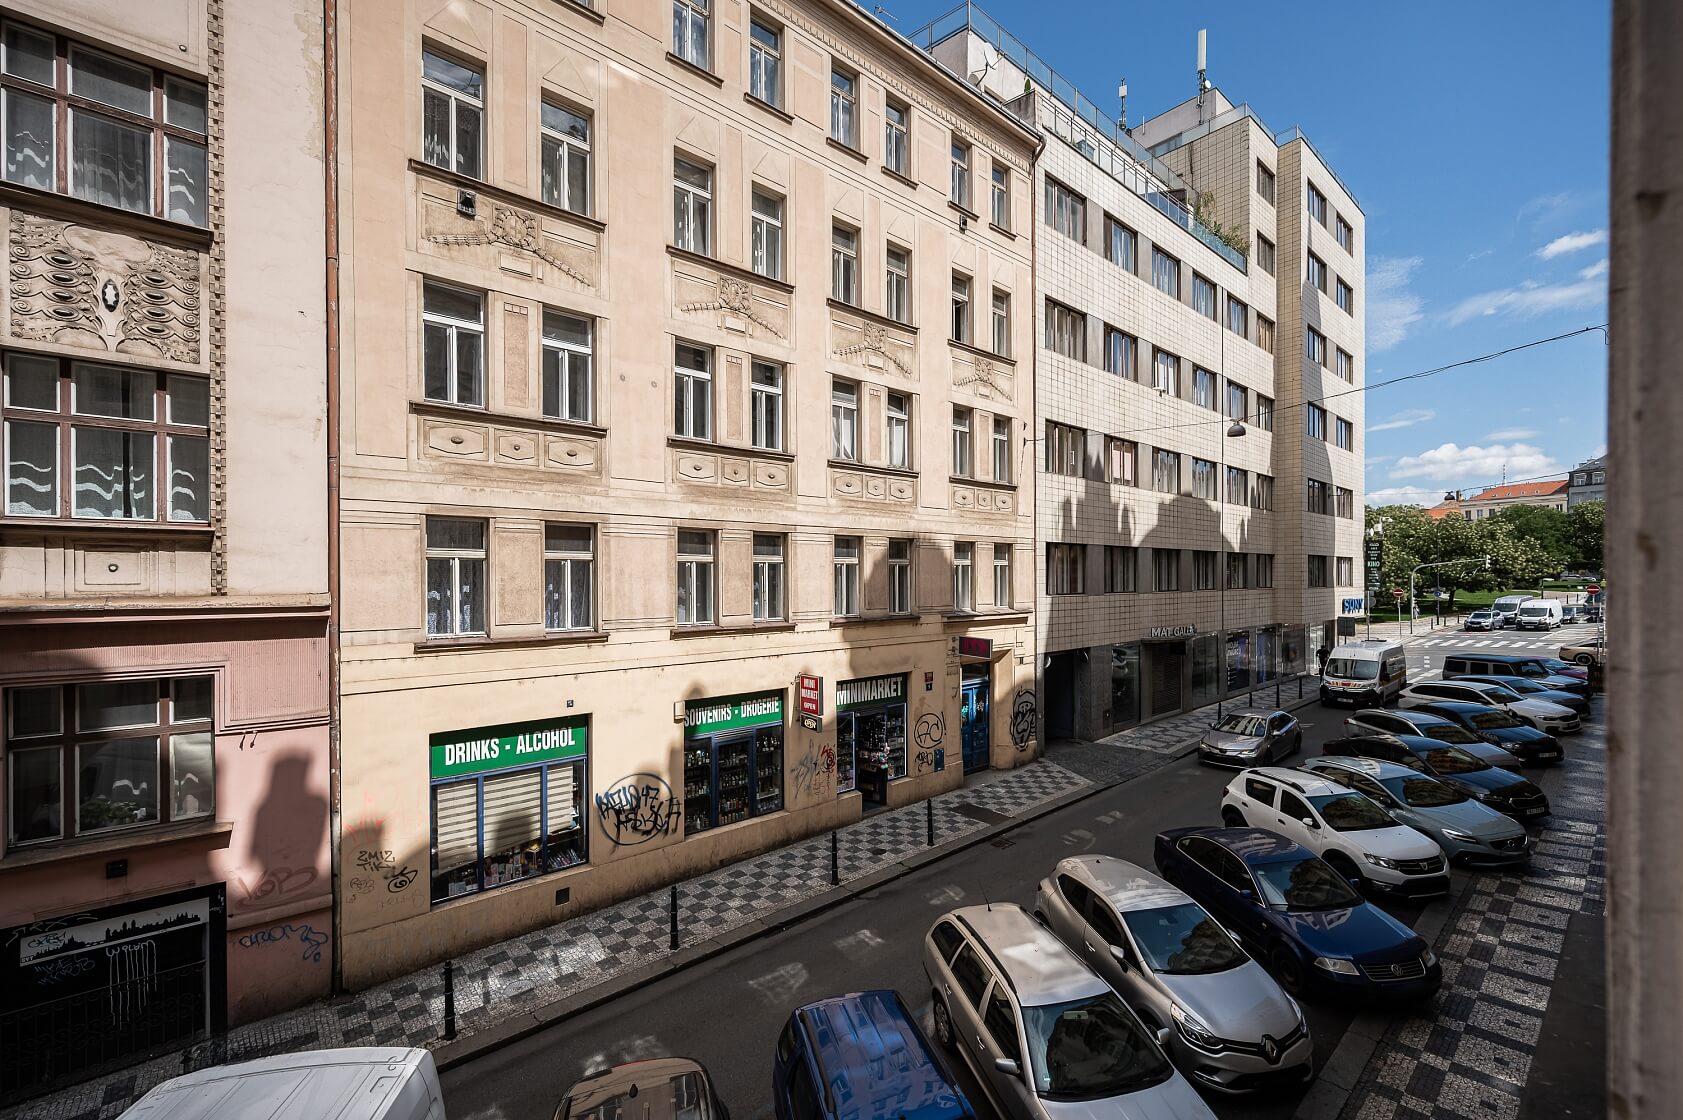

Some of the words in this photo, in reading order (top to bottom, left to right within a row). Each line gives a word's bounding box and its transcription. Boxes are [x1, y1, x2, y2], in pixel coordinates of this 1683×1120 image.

[1343, 598, 1364, 612] SONY
[836, 676, 903, 705] MINIMARKET
[684, 703, 732, 727] SOUVENIRS
[740, 696, 780, 718] DROGERIE
[803, 701, 816, 710] OPEN
[445, 737, 500, 766] DRINKS
[515, 726, 576, 755] ALCOHOL
